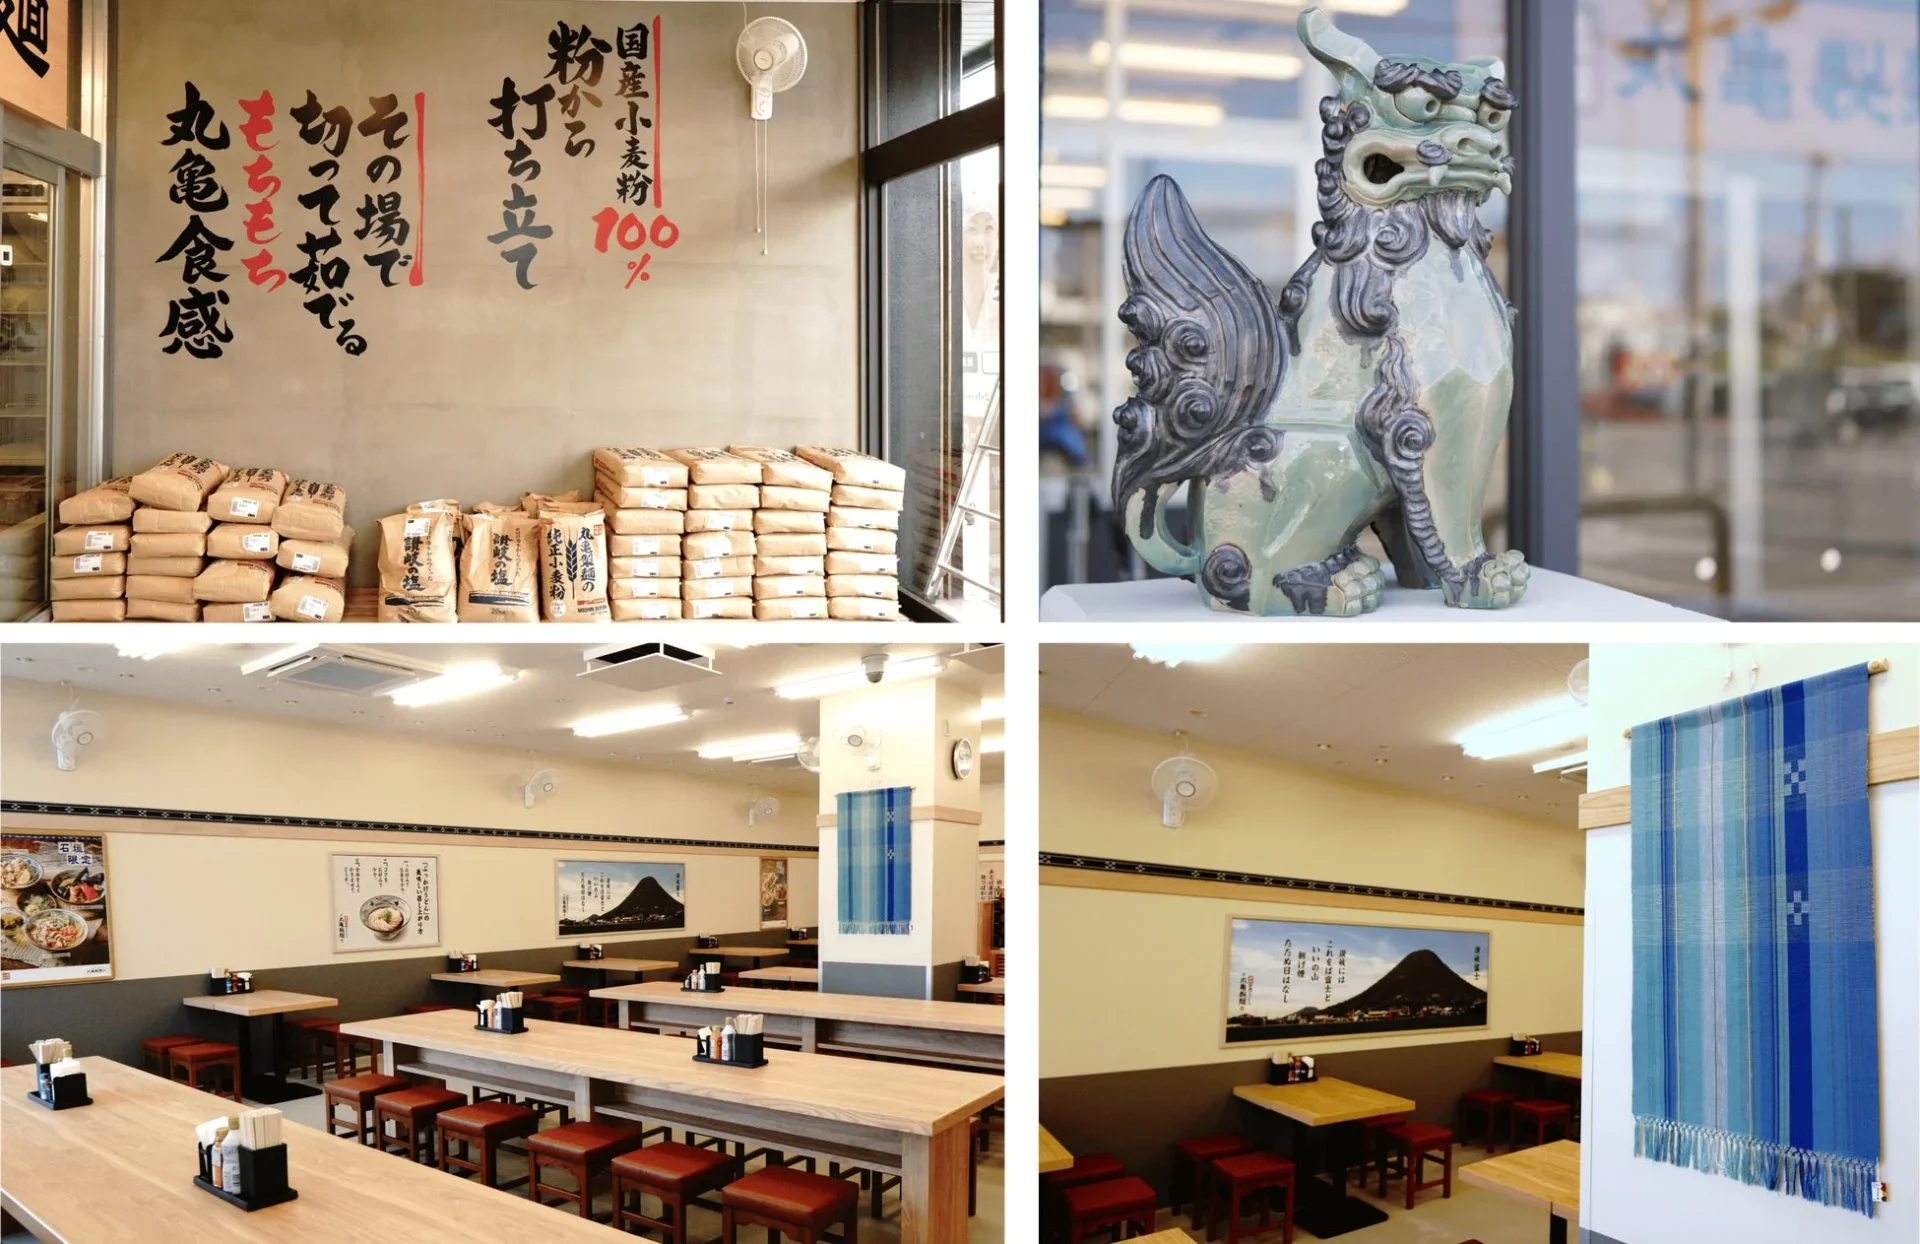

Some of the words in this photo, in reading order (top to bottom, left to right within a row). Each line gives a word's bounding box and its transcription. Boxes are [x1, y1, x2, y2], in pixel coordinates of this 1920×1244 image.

[487, 76, 556, 289] 打ち立て
[547, 20, 613, 158] 粉から
[614, 22, 653, 206] 国産小麦粉
[155, 81, 235, 360] 丸亀食感
[238, 90, 287, 293] もちもち
[288, 89, 368, 357] 切って茹でる
[354, 94, 412, 287] その場で
[546, 528, 566, 600] 純正小麦粉
[579, 527, 596, 592] 丸亀製麺の
